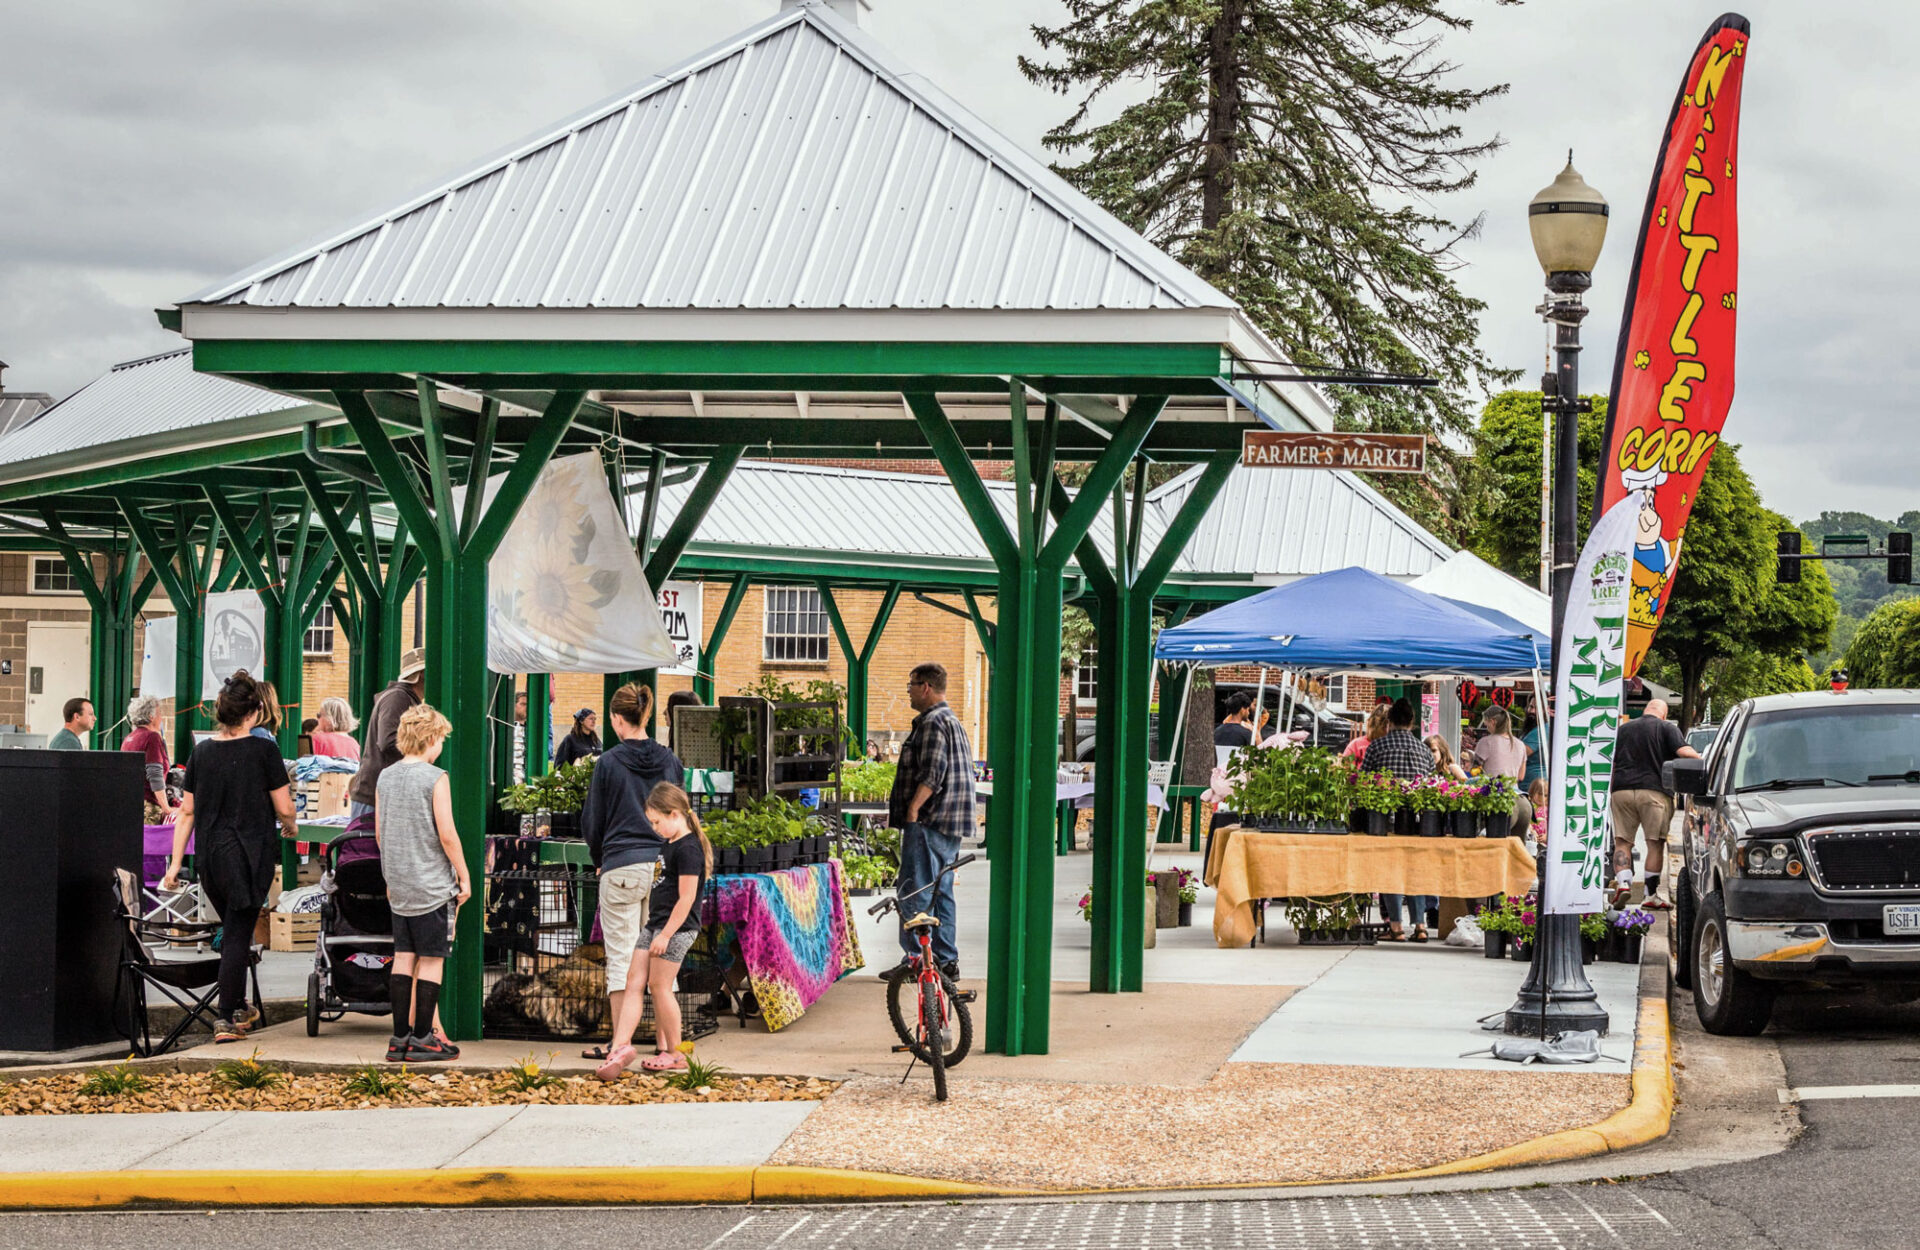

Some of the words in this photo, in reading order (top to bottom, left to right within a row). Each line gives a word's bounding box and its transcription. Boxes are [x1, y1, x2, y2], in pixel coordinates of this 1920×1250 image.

[1247, 445, 1333, 465] FARMER'S
[1342, 447, 1420, 468] MARKET
[1618, 426, 1719, 474] CORN
[660, 610, 689, 640] OM
[1561, 634, 1598, 876] MARKET
[1582, 614, 1625, 889] FARMERS
